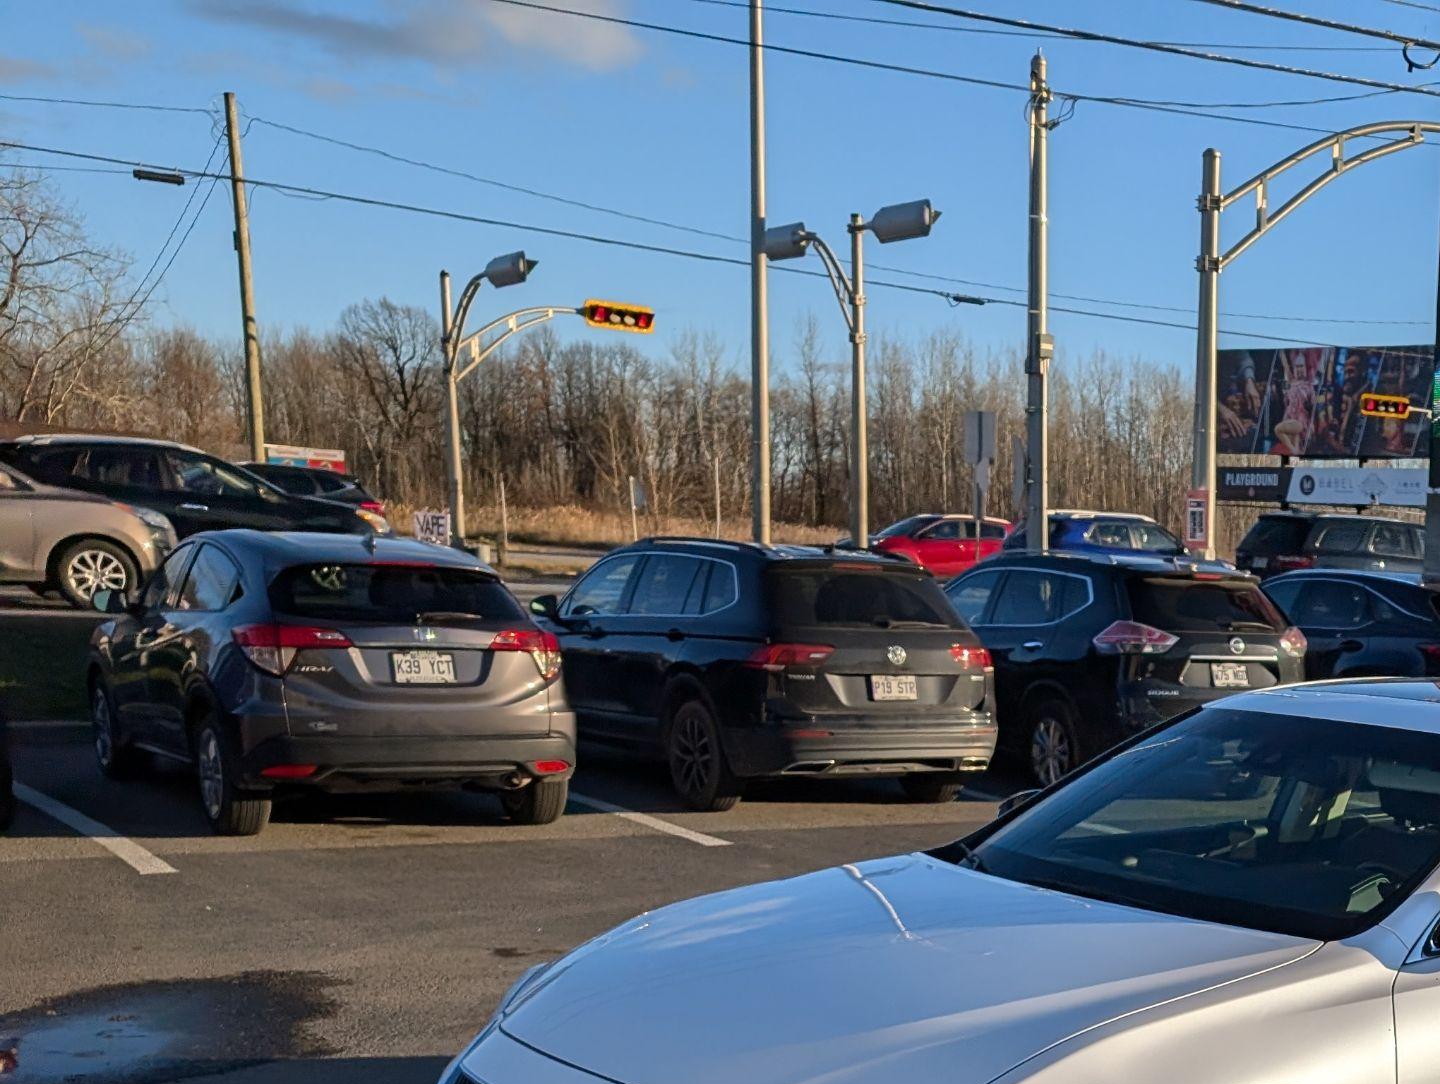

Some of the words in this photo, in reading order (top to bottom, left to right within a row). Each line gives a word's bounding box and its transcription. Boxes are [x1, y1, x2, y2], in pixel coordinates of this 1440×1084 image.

[1225, 472, 1279, 486] PLAYGROUND
[416, 514, 445, 536] VAPE
[396, 659, 421, 675] K39
[429, 660, 452, 675] YCT
[897, 681, 916, 694] STR
